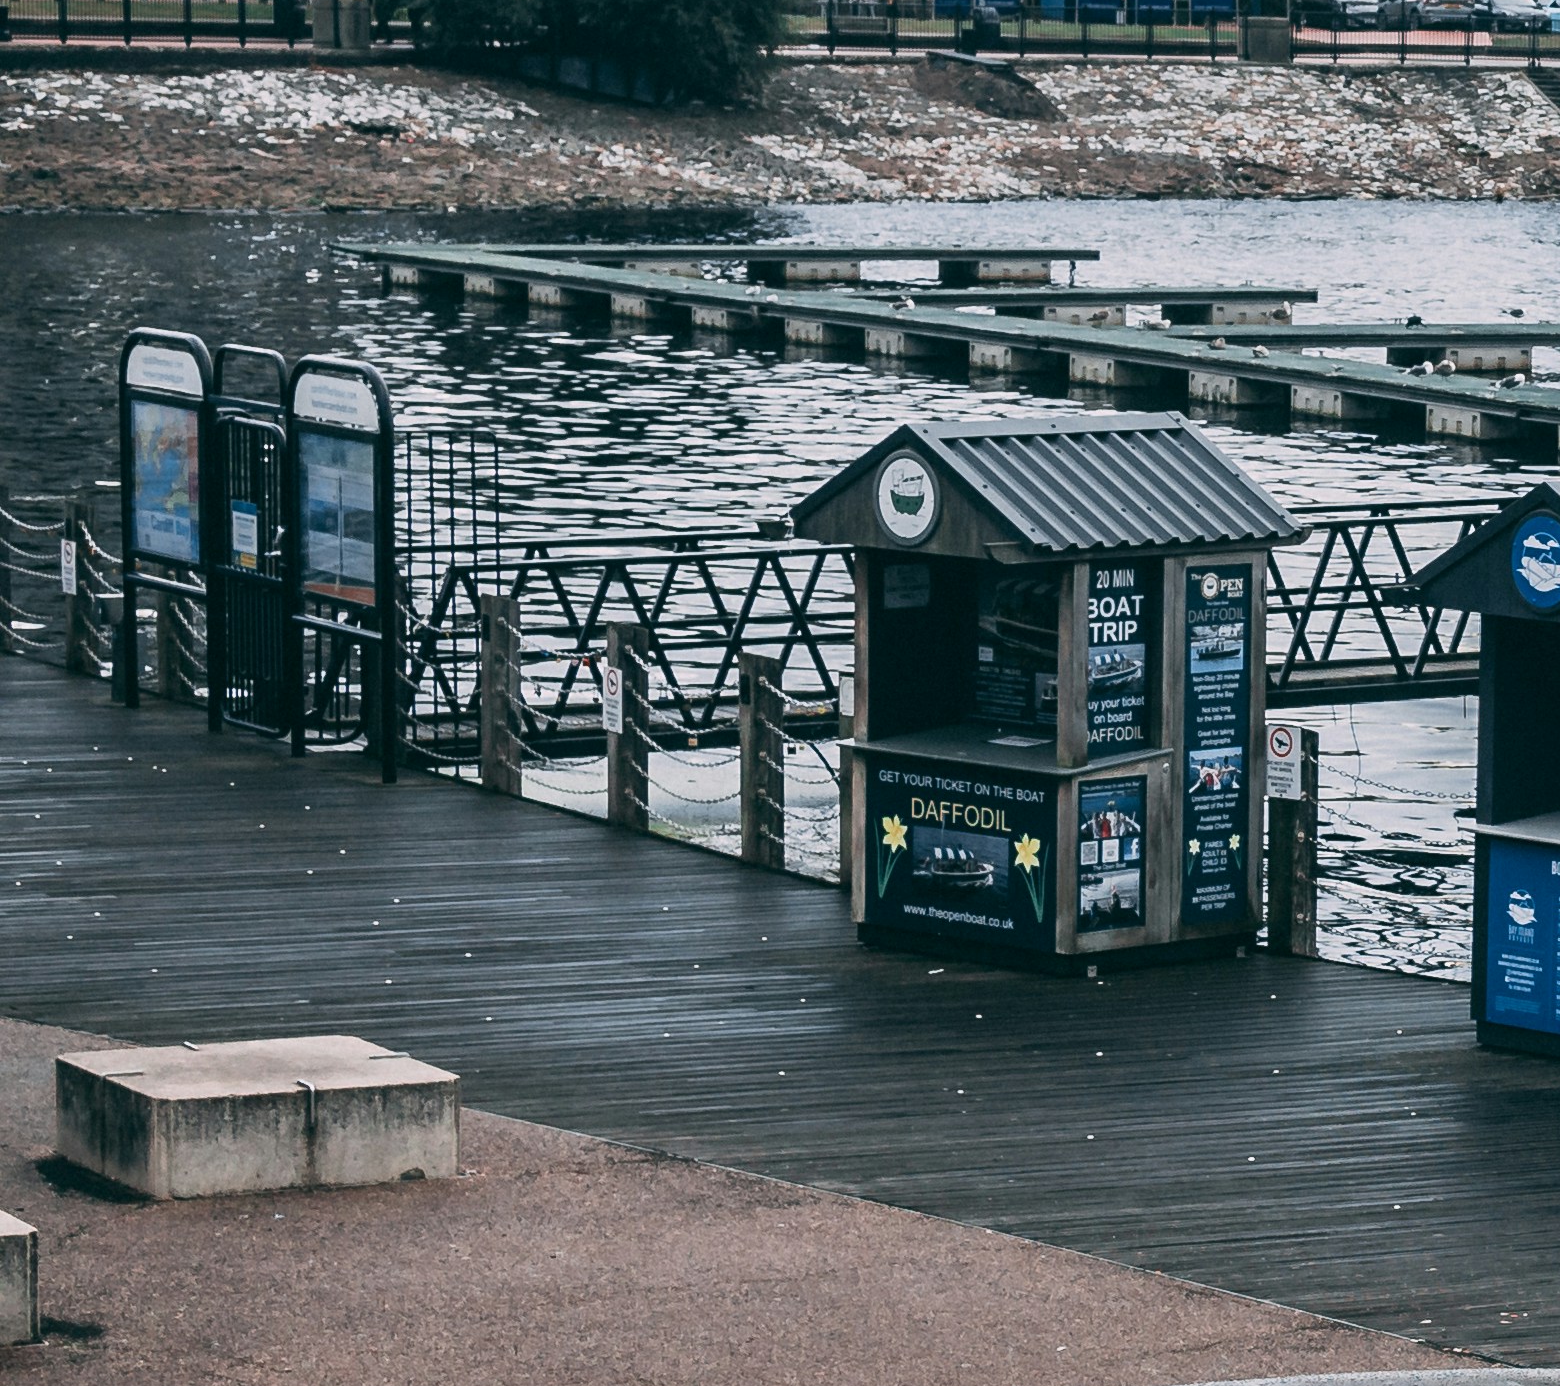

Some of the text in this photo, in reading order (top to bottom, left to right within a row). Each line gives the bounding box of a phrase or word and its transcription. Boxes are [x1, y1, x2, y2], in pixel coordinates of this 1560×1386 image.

[1096, 568, 1135, 589] 20 MIN
[1088, 595, 1145, 619] BOAT
[1188, 606, 1246, 624] DAFFODIL
[1089, 620, 1138, 643] TRIP
[1088, 694, 1145, 711] uy your ticket
[1093, 711, 1133, 725] on board
[878, 769, 1045, 803] GET YOUR TICKET ON THE BOAT
[911, 797, 1012, 832] DAFFODIL
[903, 904, 1014, 929] www.theopenboat.co.uk
